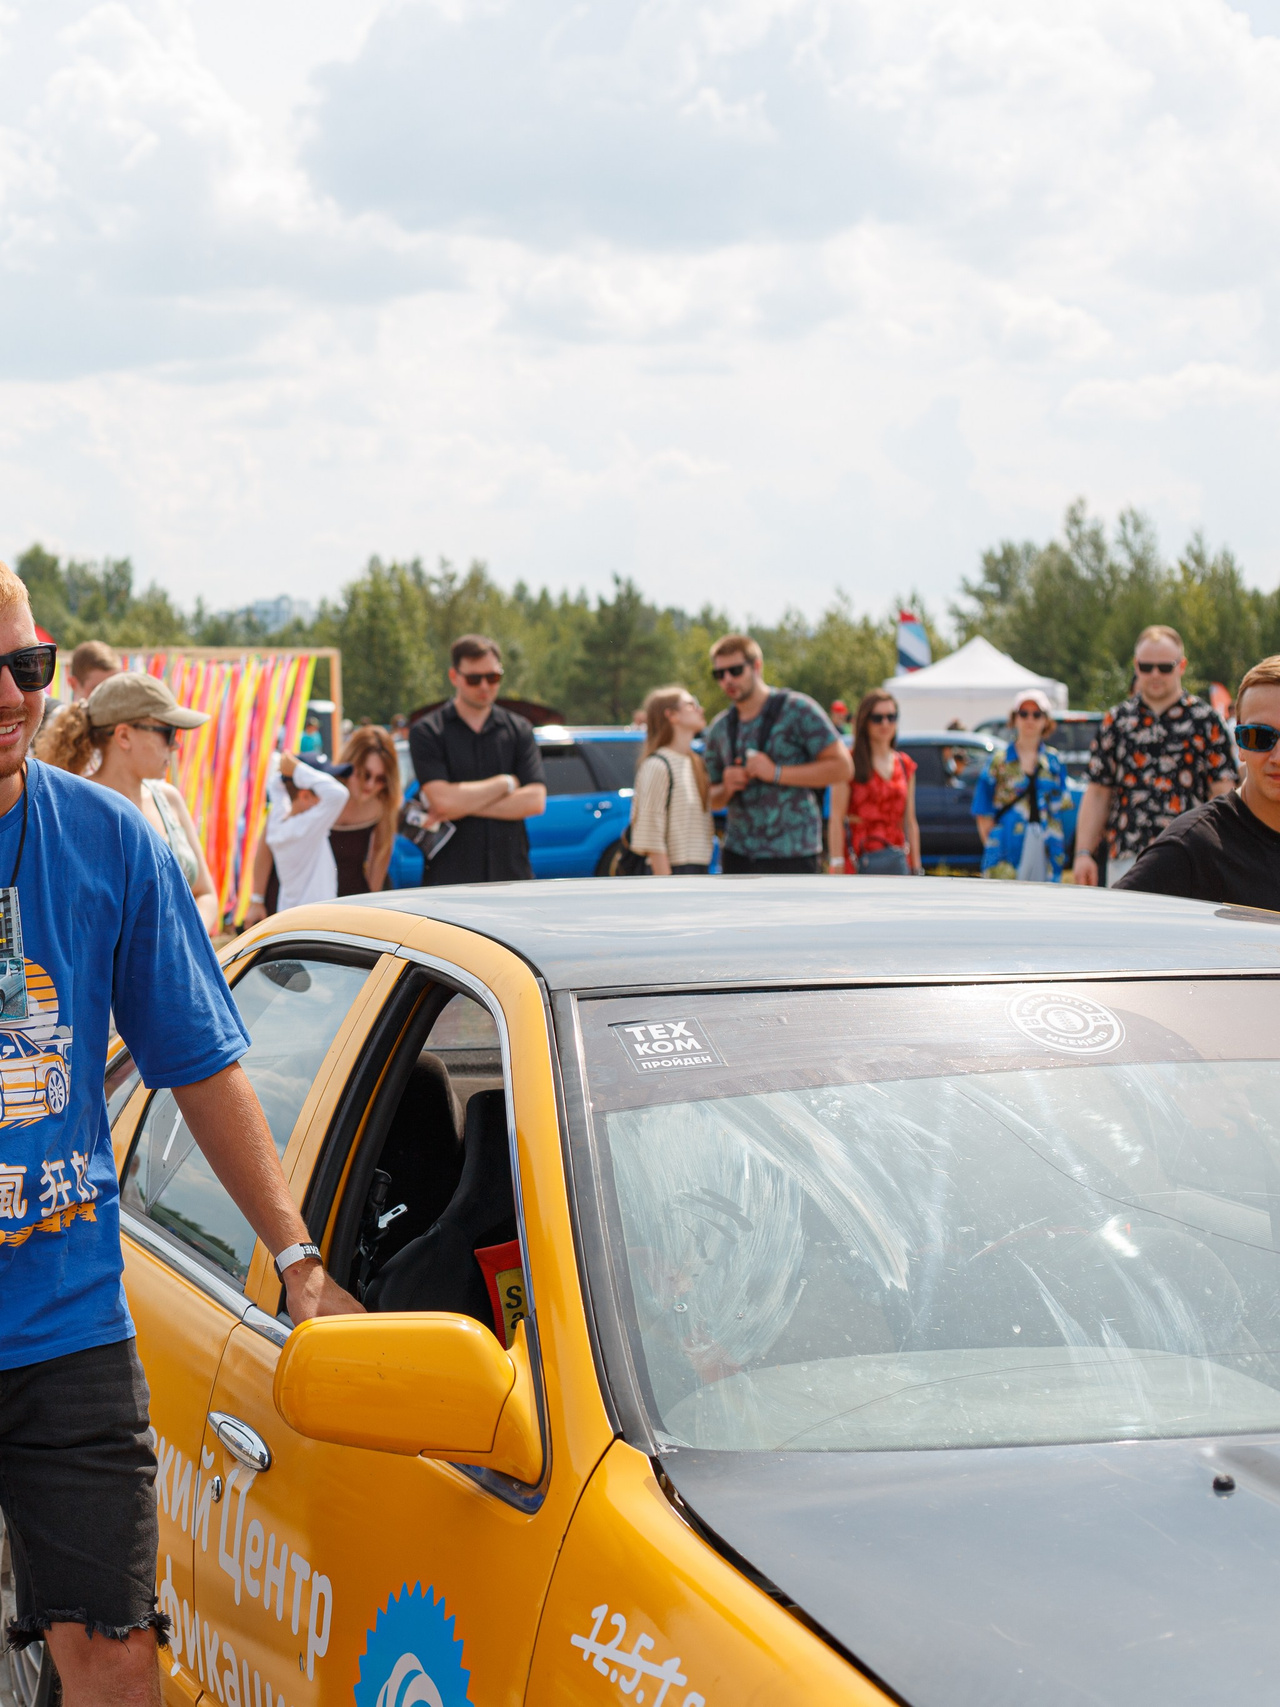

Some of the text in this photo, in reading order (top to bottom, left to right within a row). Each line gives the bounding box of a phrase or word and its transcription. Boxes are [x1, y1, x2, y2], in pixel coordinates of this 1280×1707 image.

[1050, 996, 1095, 1013] AUTO
[1046, 1031, 1109, 1047] WEEKEND
[640, 1055, 713, 1070] ПРОЙДЕН
[150, 1426, 333, 1682] кий Центр
